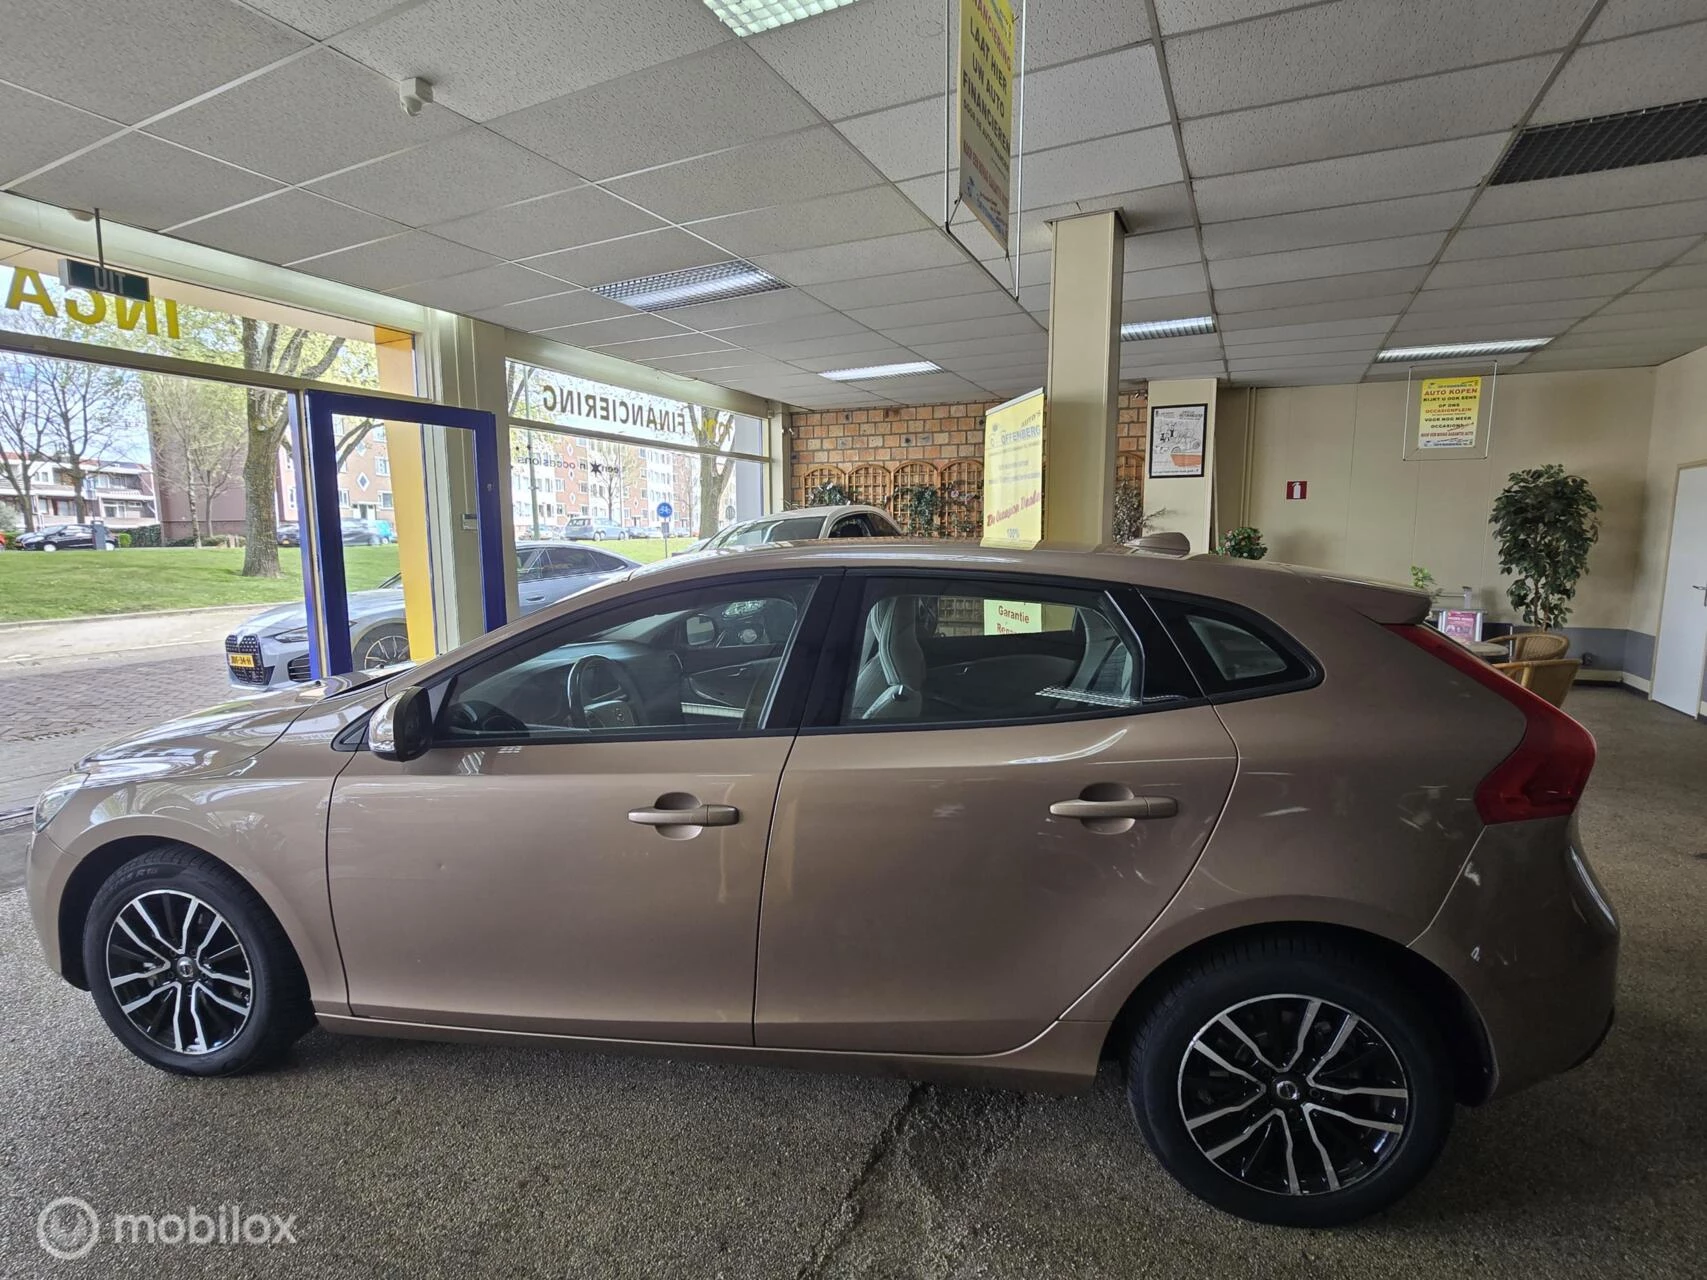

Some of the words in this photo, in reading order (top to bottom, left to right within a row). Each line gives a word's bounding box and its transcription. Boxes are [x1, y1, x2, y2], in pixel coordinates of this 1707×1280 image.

[970, 15, 990, 62] LAAT
[991, 54, 1007, 95] HIER
[973, 51, 985, 85] UW
[986, 78, 1005, 118] AUTO
[963, 68, 1011, 158] FINANCIEREN
[95, 266, 126, 294] UIT
[1001, 425, 1041, 447] OFFENBERG
[998, 605, 1030, 624] Garantie
